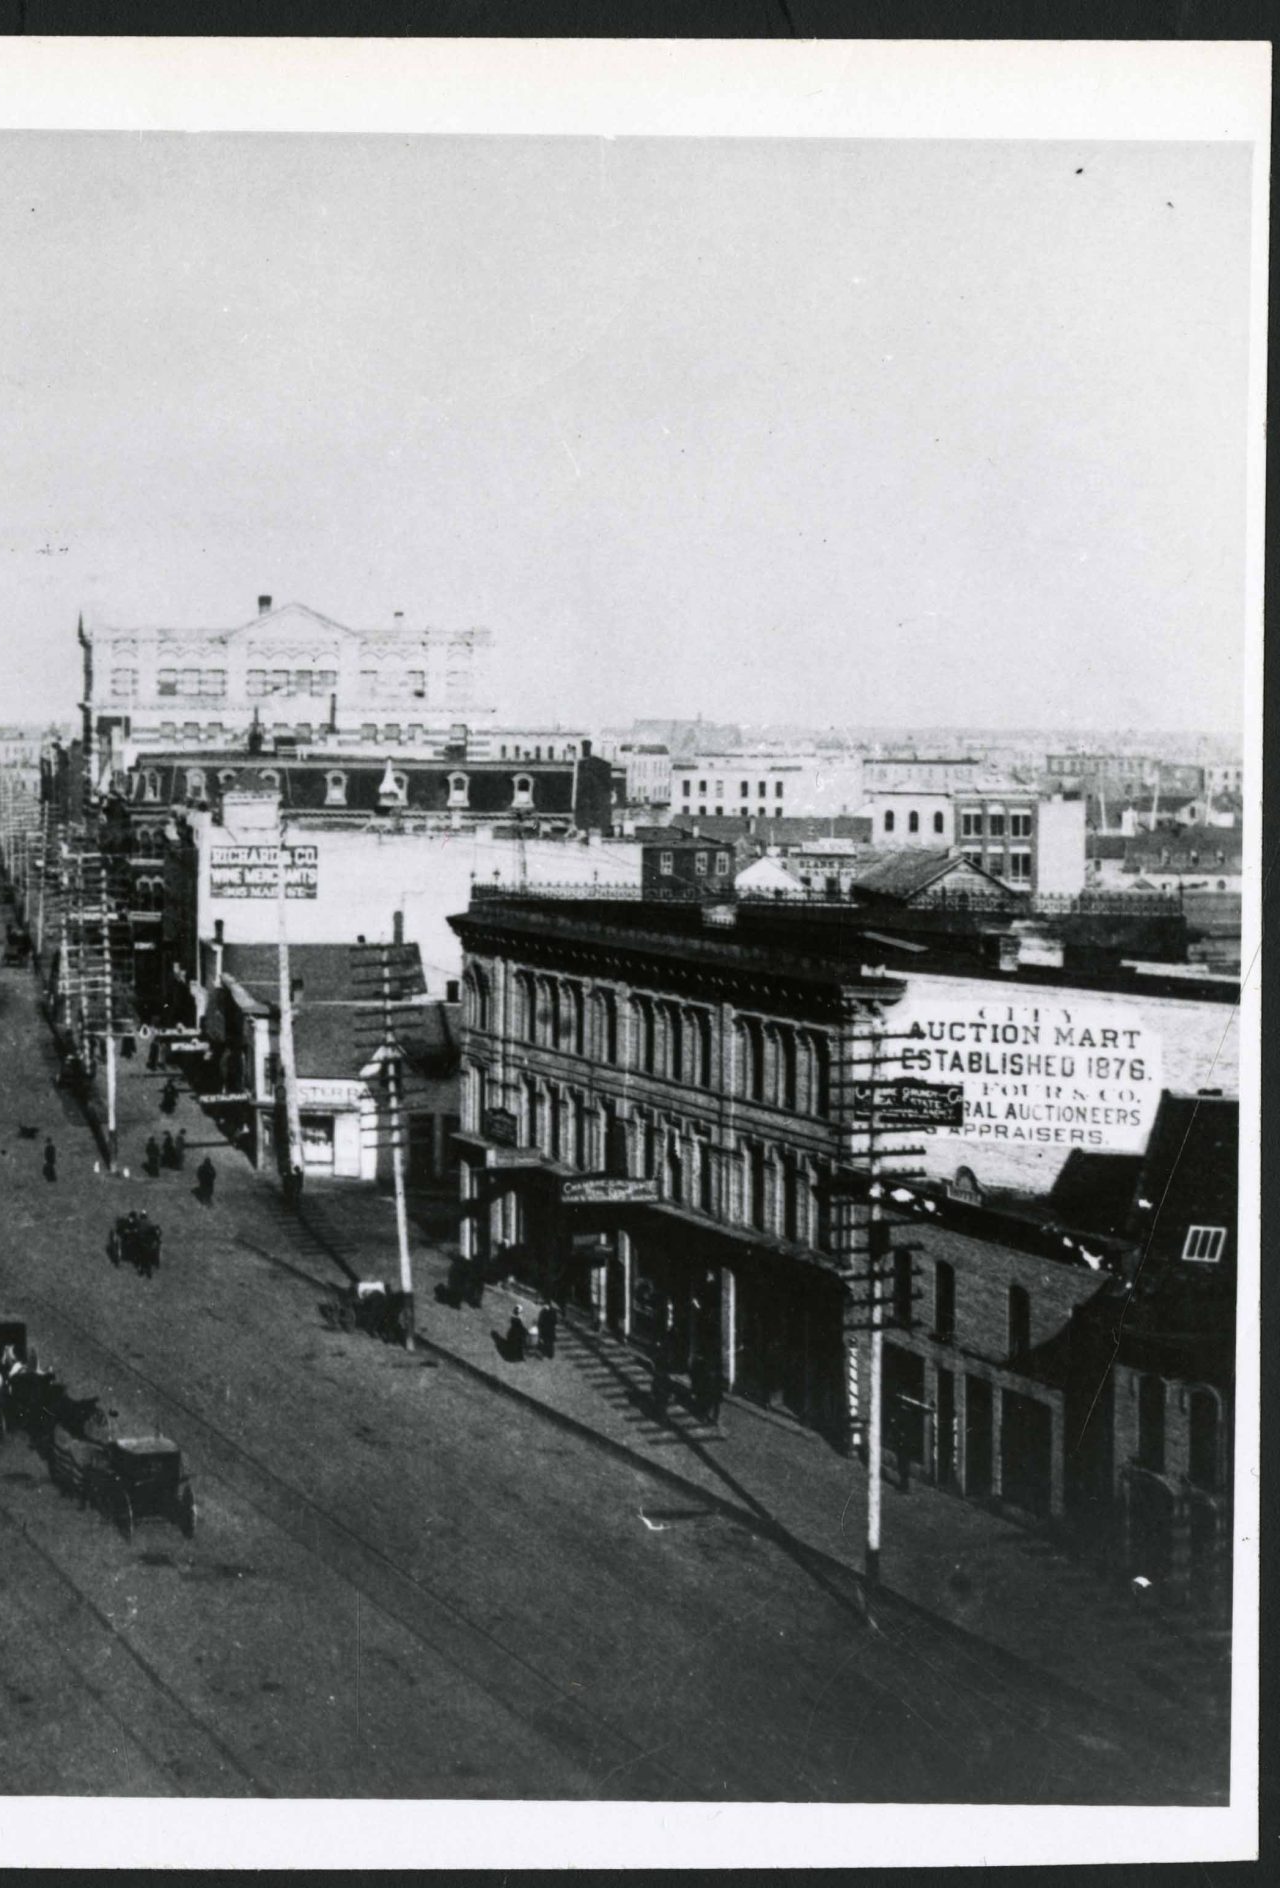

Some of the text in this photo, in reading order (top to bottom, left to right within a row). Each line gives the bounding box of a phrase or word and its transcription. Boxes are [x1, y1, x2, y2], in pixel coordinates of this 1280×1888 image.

[210, 848, 280, 865] RICHARD
[210, 867, 318, 884] WINE MERCANTS
[250, 886, 282, 898] MAI
[978, 1006, 1076, 1024] CITY
[909, 1021, 1141, 1049] AUCTION MART
[901, 1047, 1075, 1078] ESTABLISHED
[1005, 1101, 1142, 1127] AUCTIONEERS
